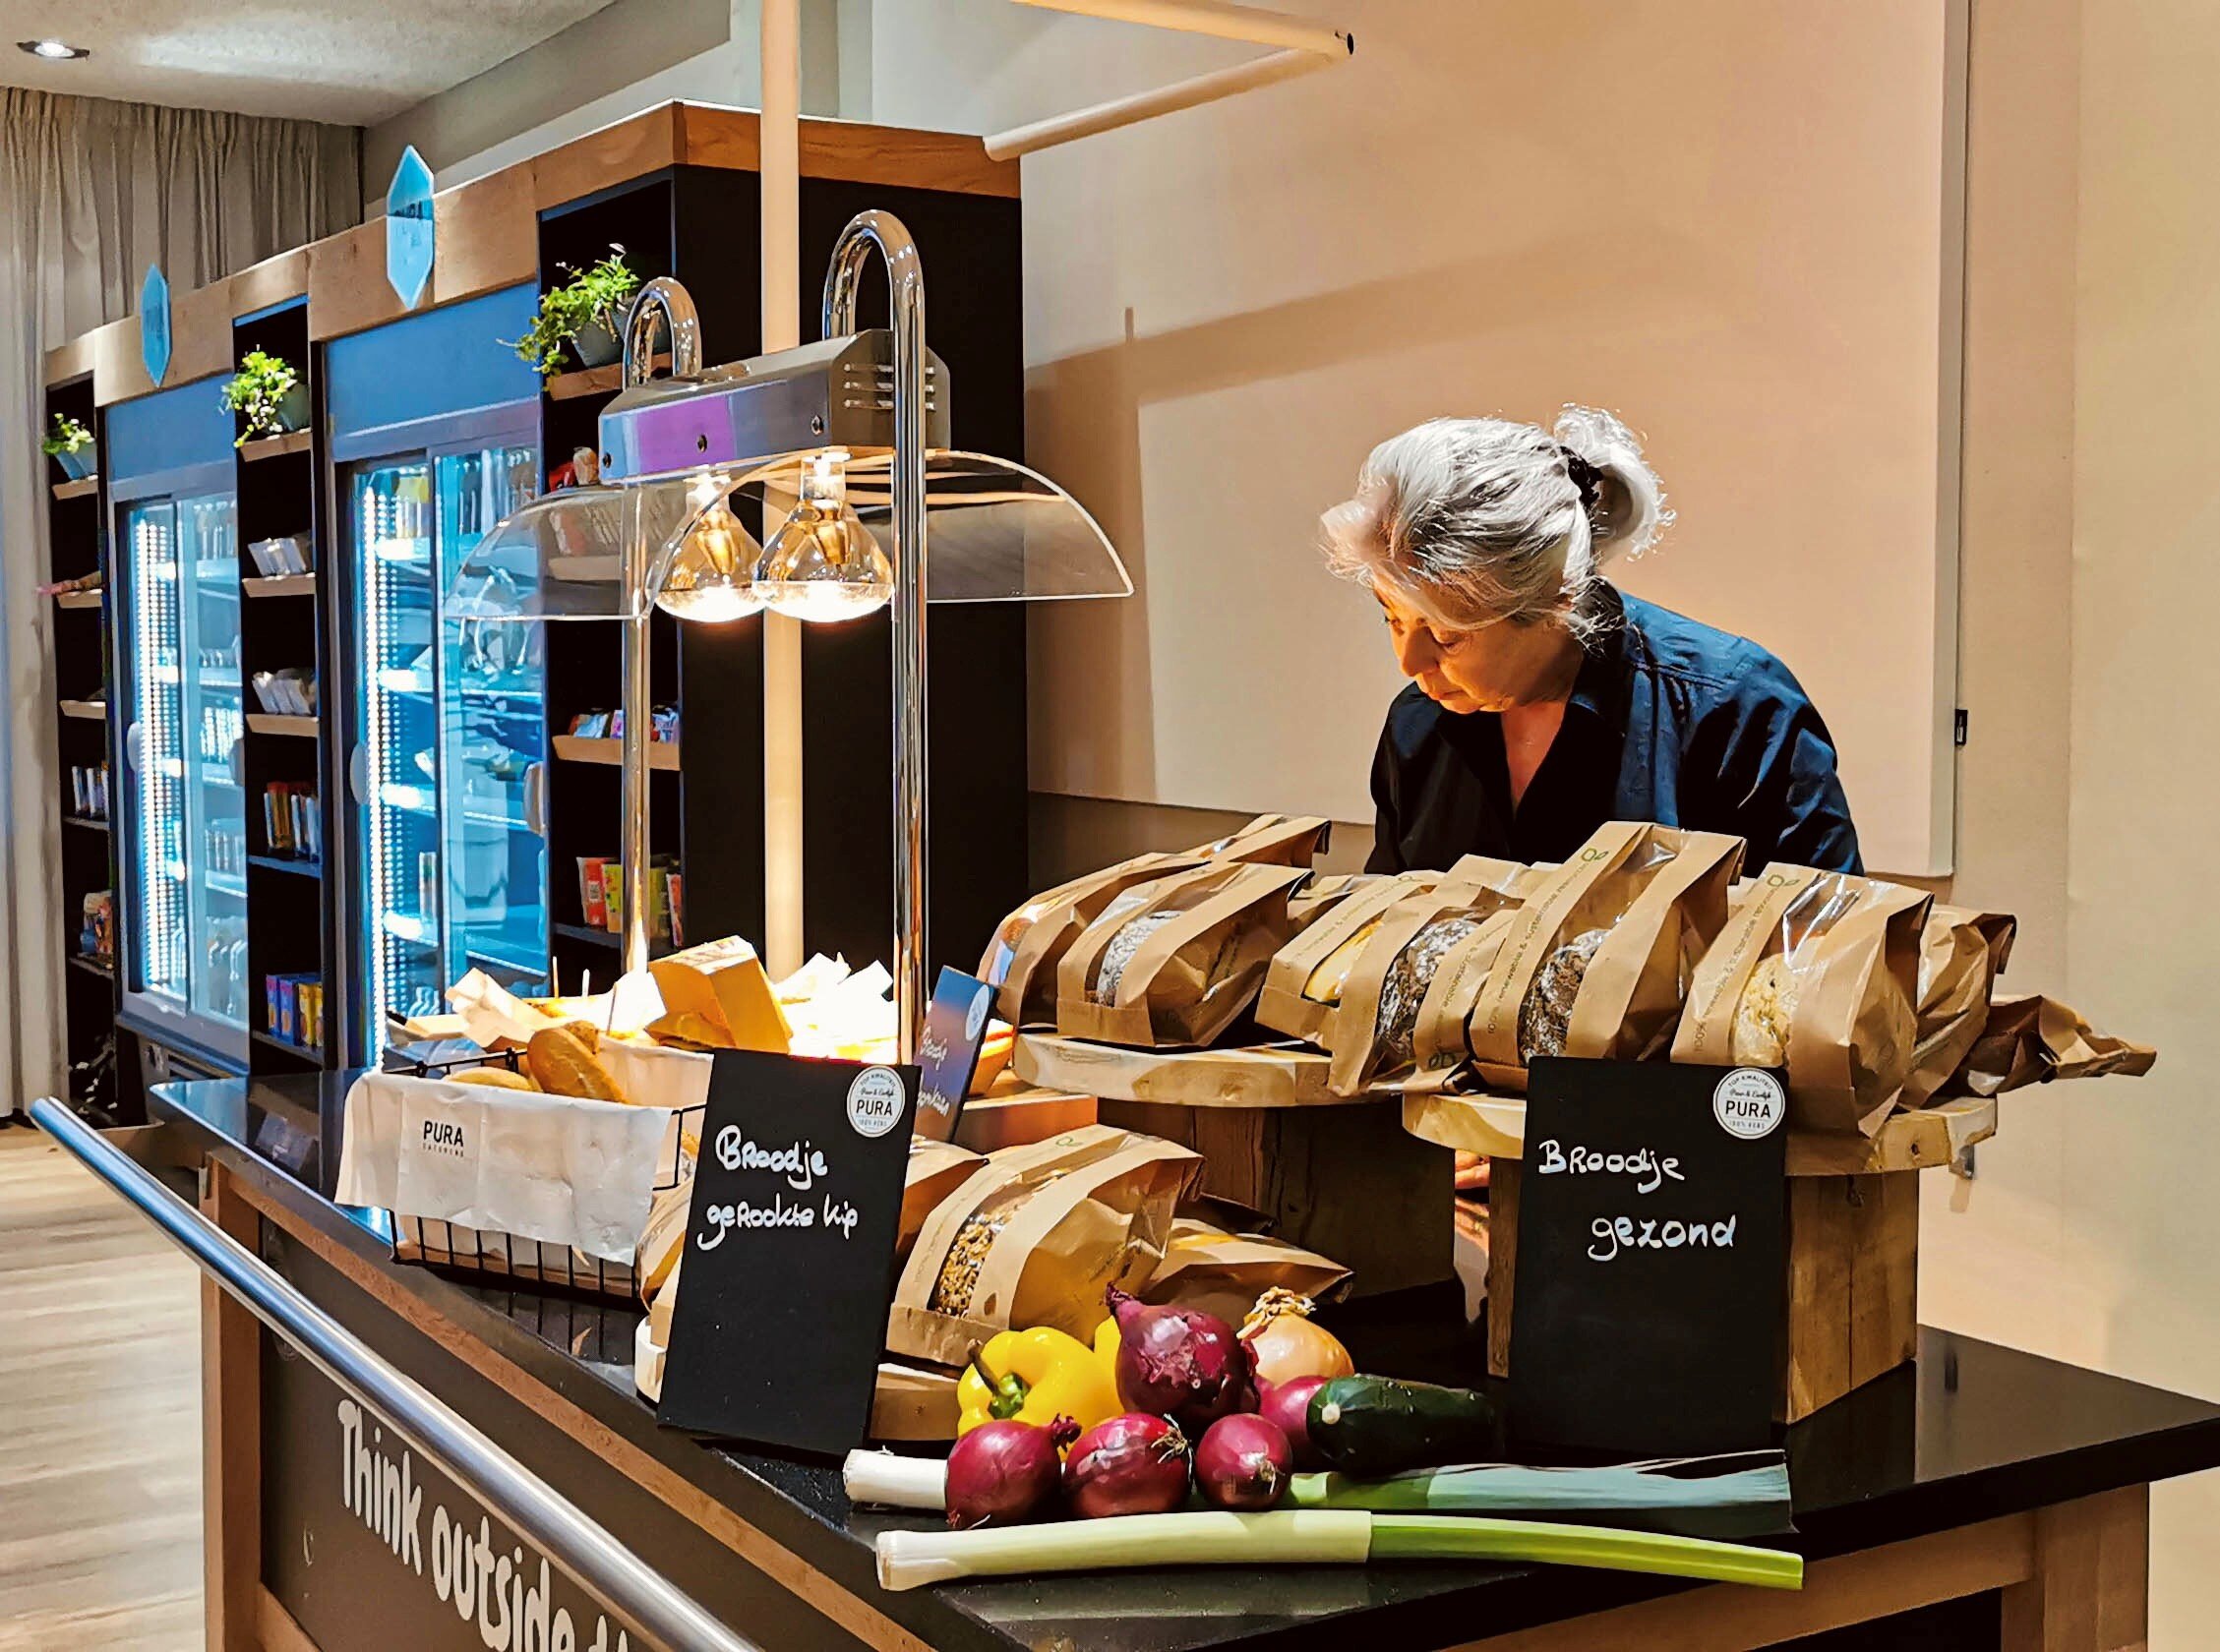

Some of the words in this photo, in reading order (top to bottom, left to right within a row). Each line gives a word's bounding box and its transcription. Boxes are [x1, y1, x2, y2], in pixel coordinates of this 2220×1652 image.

[856, 1099, 892, 1116] PURA
[1725, 1099, 1770, 1118] PURA
[423, 1120, 464, 1148] PURA
[823, 1193, 859, 1240] kip
[1587, 1214, 1736, 1262] gezond
[337, 1399, 422, 1576] Think
